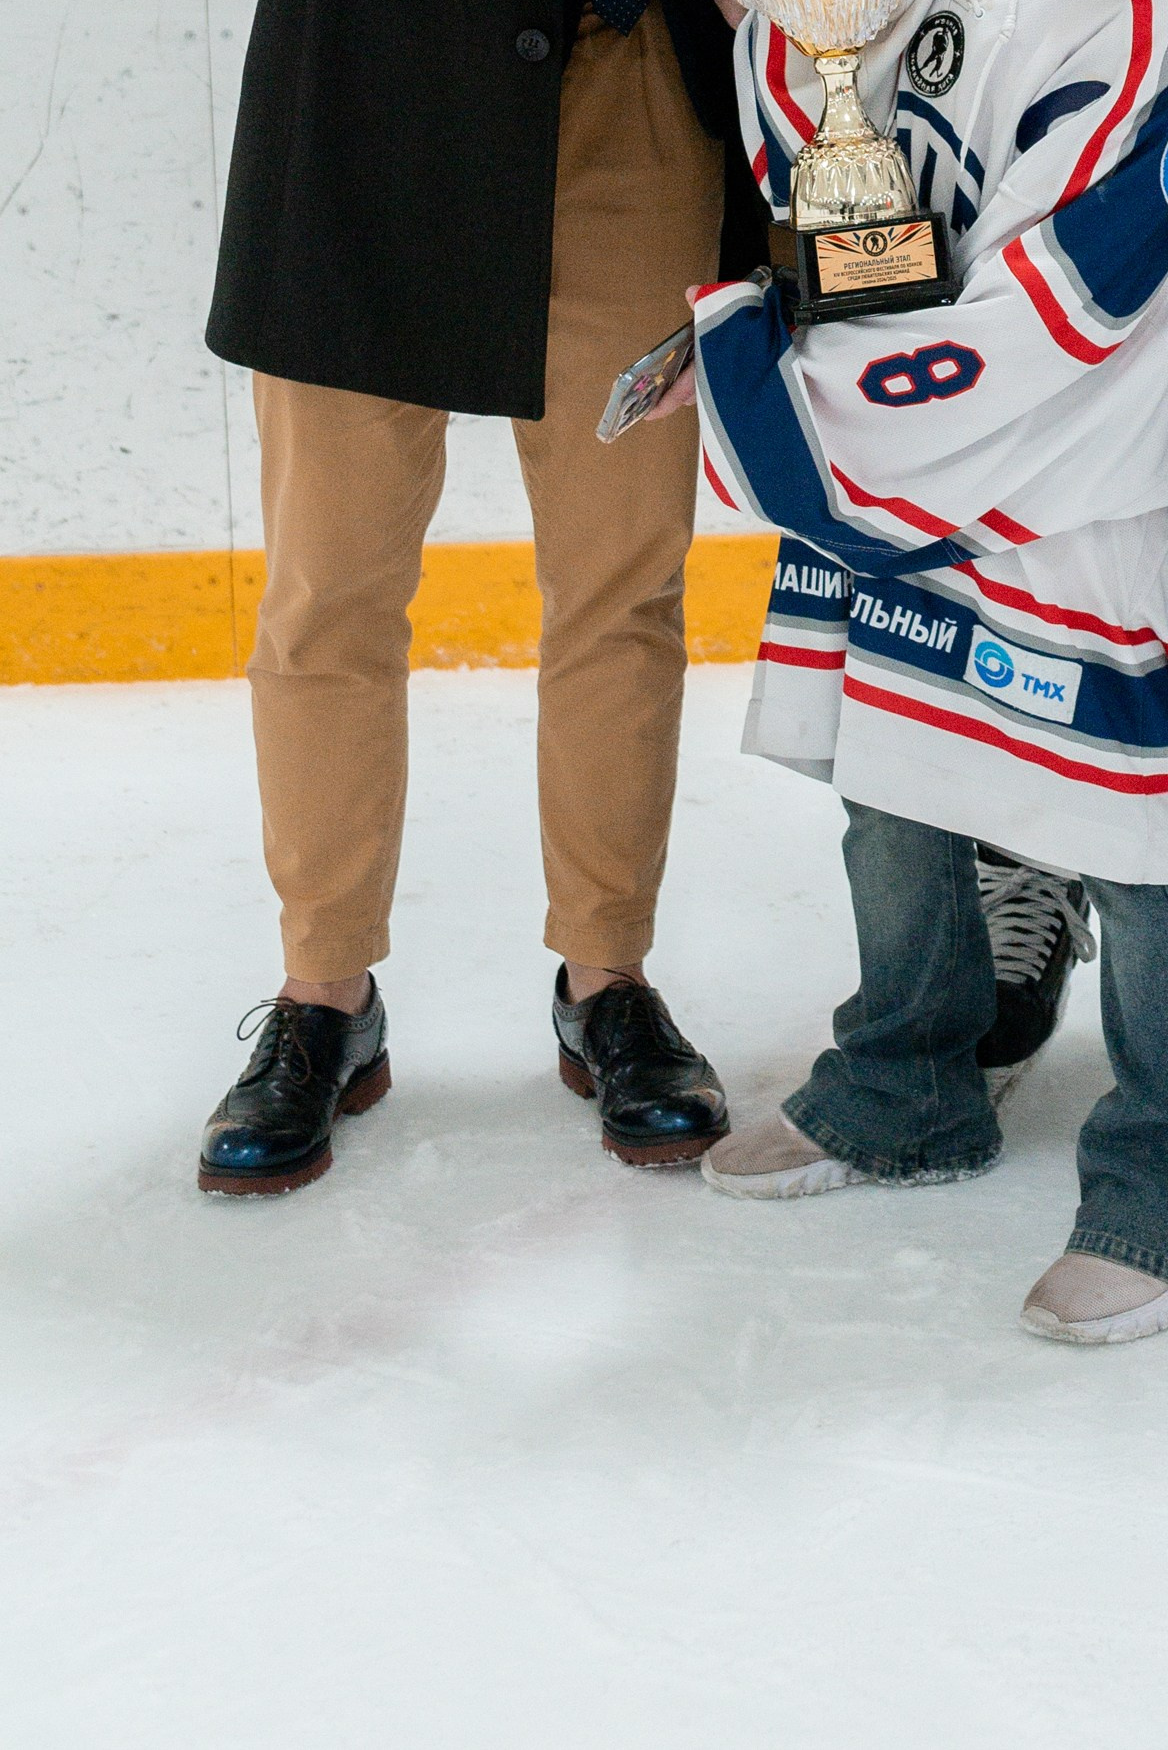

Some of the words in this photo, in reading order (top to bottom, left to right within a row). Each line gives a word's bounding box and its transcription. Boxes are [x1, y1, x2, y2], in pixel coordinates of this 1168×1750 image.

[844, 255, 894, 270] РЕГИОНАЛЬНЫЙ
[896, 254, 911, 262] ЭТАП
[850, 587, 958, 654] ЛЬНЫЙ
[1021, 673, 1067, 703] ТМХ
